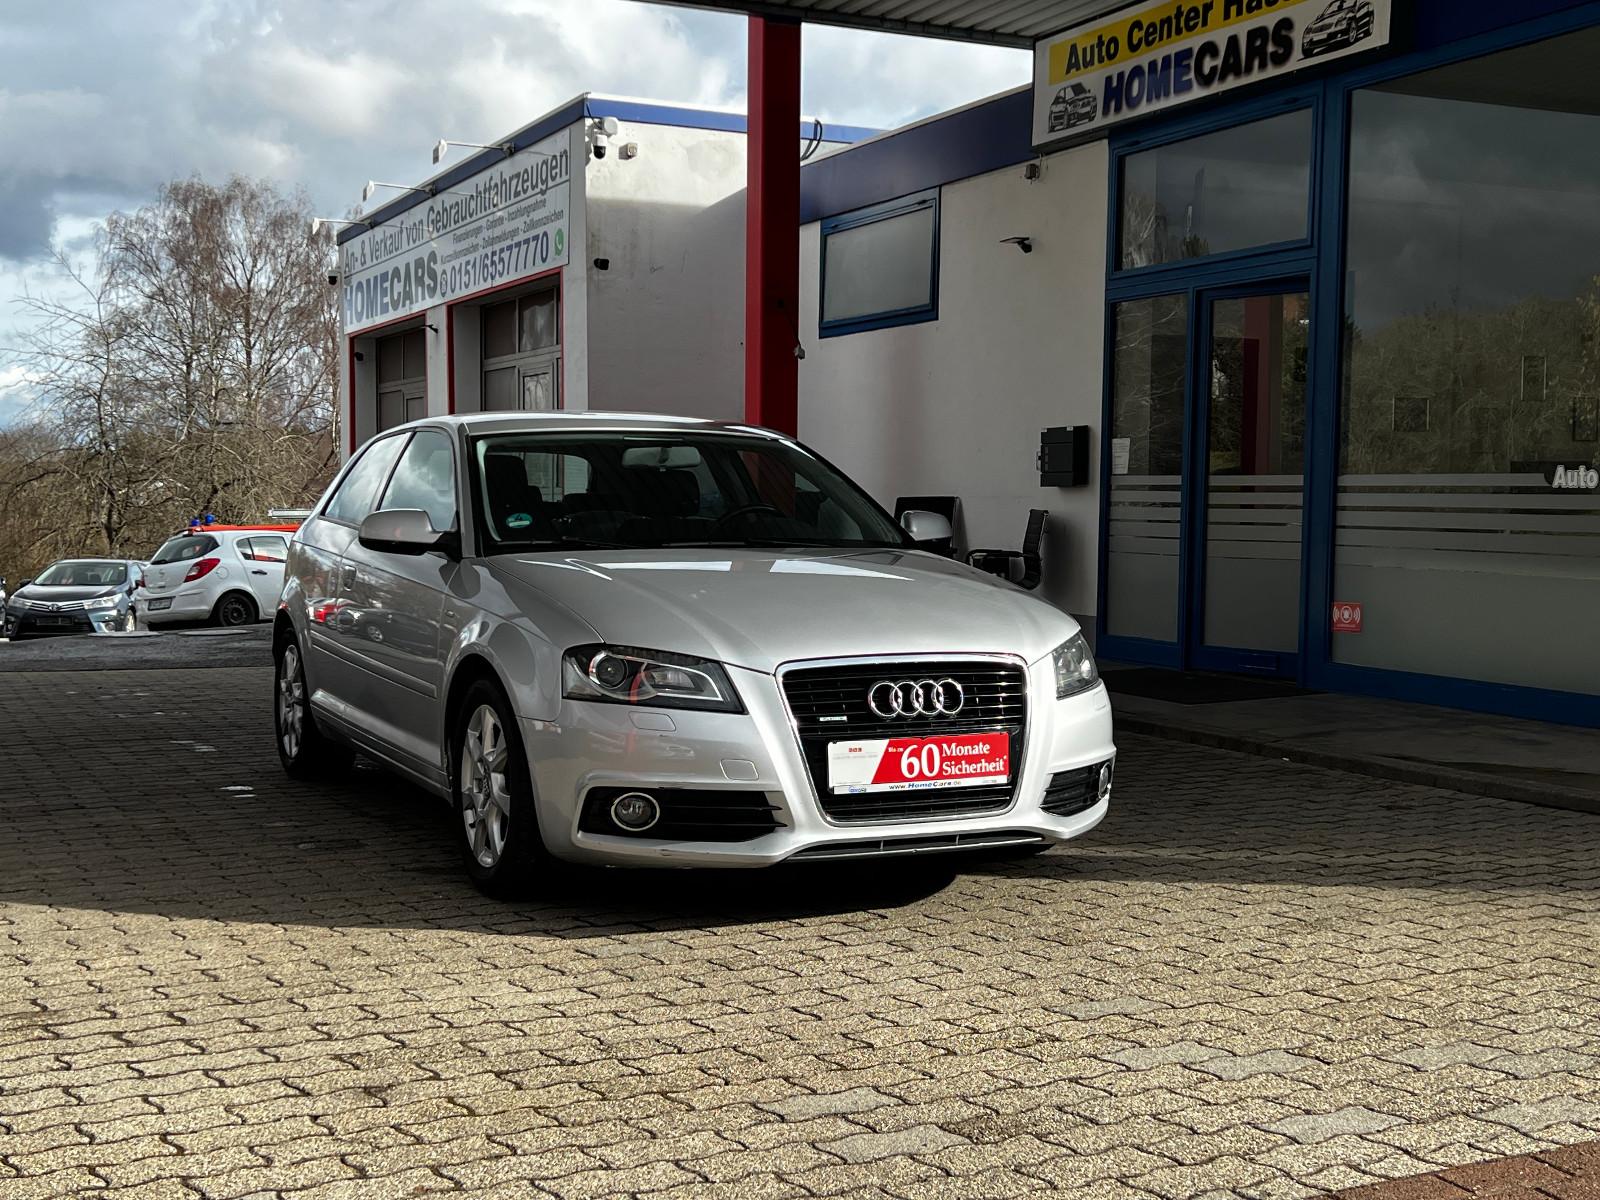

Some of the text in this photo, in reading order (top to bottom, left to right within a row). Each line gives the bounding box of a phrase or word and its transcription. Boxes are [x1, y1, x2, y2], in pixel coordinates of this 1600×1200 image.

[1065, 33, 1120, 75] Auto
[1127, 0, 1214, 53] Center
[1102, 17, 1294, 119] HOMECARS
[360, 239, 367, 267] &
[368, 220, 404, 263] Verkauf
[405, 218, 424, 247] von
[427, 148, 569, 235] Gebrauchtfahrzeugen
[344, 250, 438, 327] HOMECARS
[450, 230, 549, 293] 0151/65577770
[1551, 464, 1600, 488] Auto
[901, 743, 940, 778] 60
[941, 741, 990, 757] Monate
